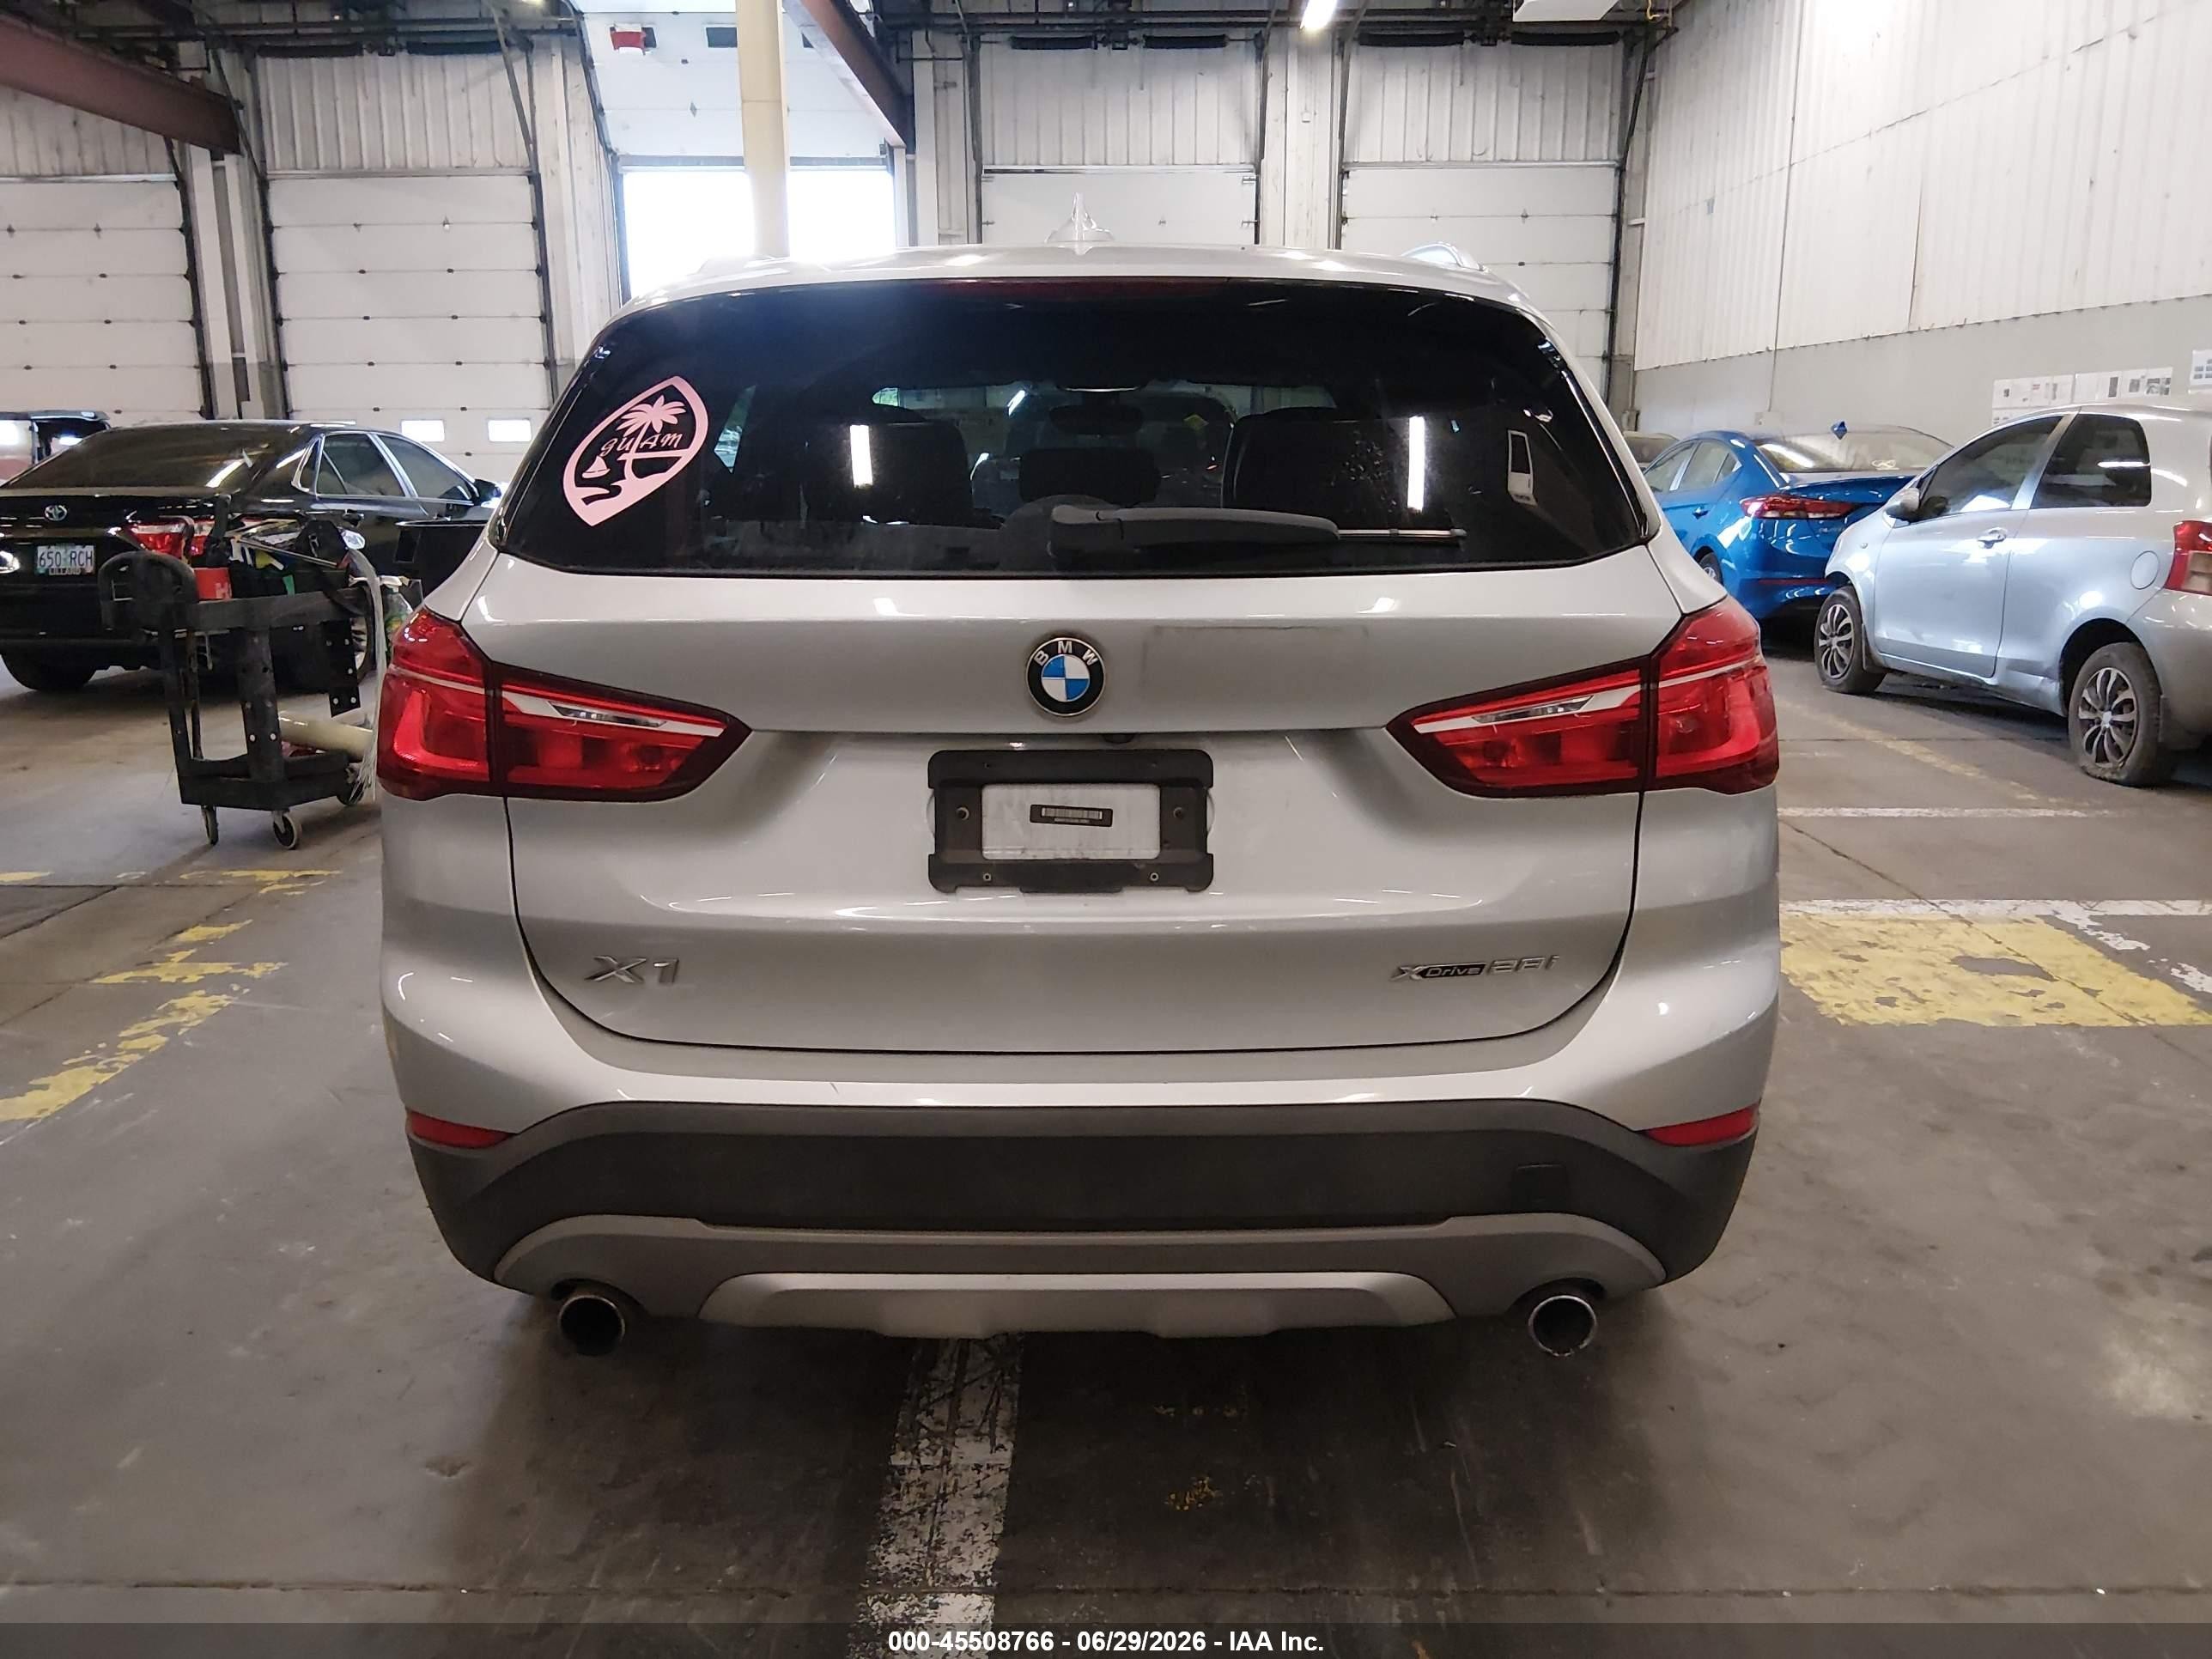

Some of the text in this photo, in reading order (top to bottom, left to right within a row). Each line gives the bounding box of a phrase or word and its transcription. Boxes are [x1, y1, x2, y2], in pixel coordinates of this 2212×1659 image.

[39, 550, 93, 568] 650 RCH
[1033, 640, 1099, 667] BMW
[585, 955, 679, 984] X1
